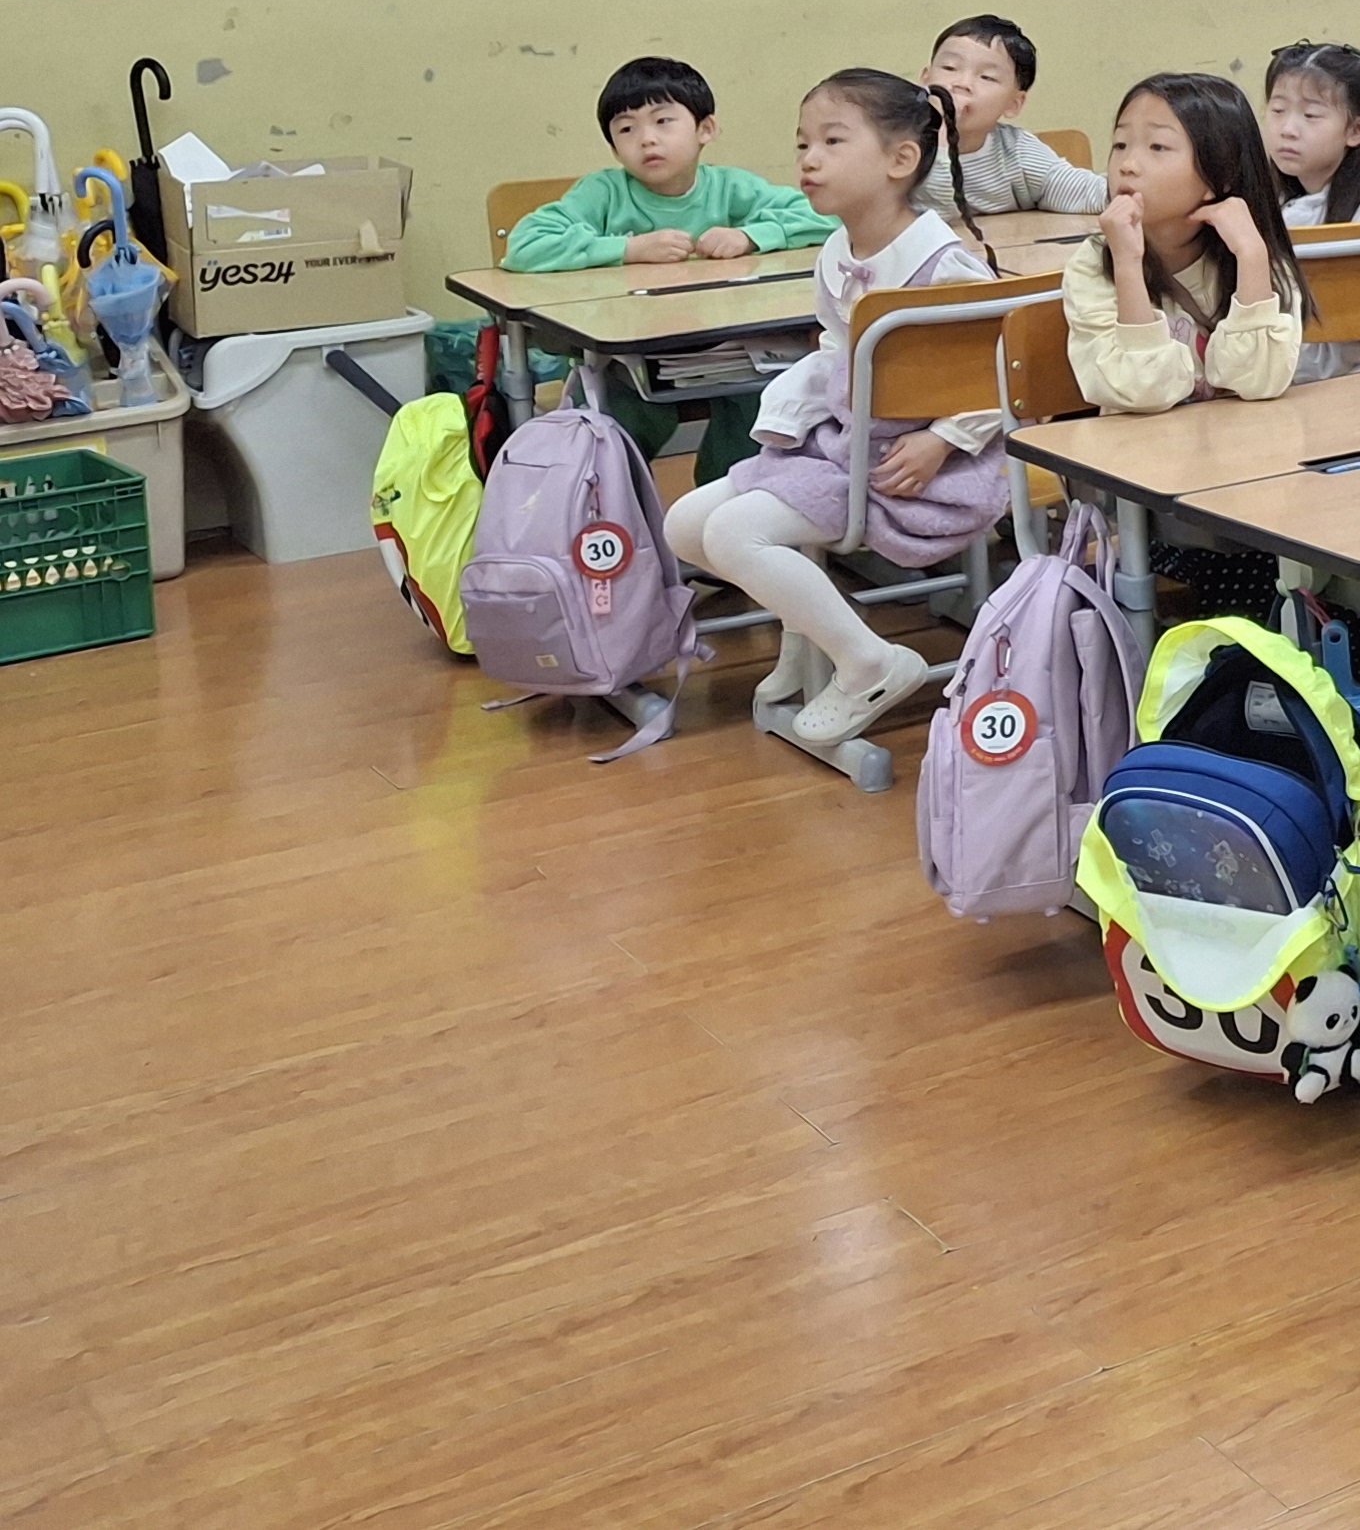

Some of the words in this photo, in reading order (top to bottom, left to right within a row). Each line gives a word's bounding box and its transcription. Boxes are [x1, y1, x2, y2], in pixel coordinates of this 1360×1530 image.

[304, 257, 331, 269] YOUR
[587, 539, 615, 562] 30
[980, 714, 1016, 740] 30
